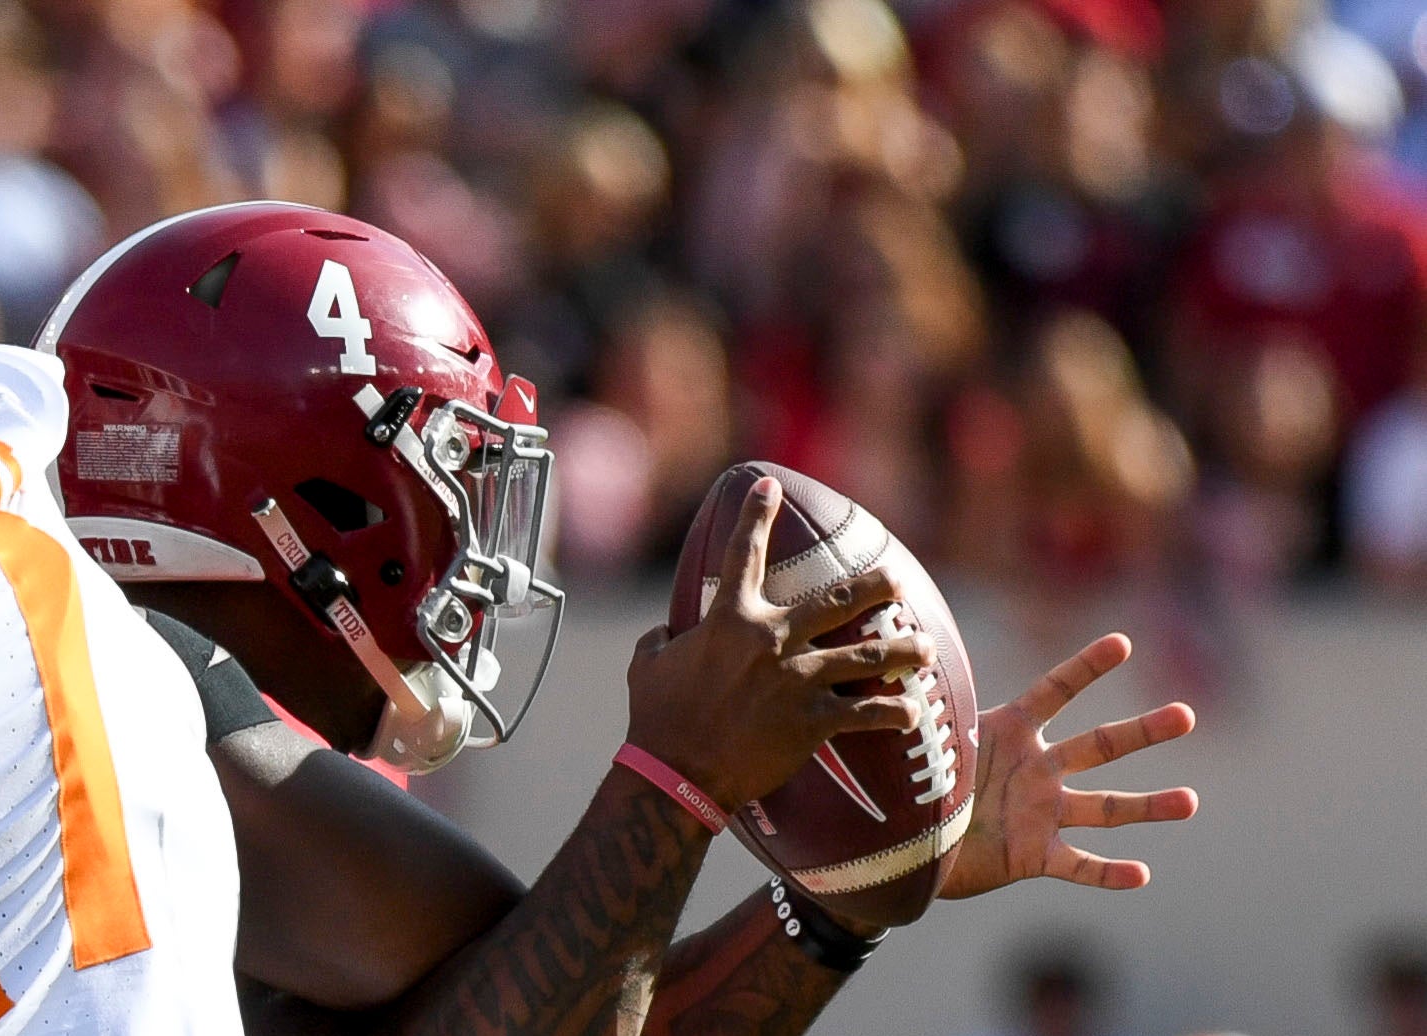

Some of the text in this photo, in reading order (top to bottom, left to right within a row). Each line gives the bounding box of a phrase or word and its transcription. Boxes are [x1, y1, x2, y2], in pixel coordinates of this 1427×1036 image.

[307, 259, 376, 376] 4
[103, 424, 147, 433] WARNING
[78, 537, 157, 566] TIDE
[333, 600, 367, 642] TIDE
